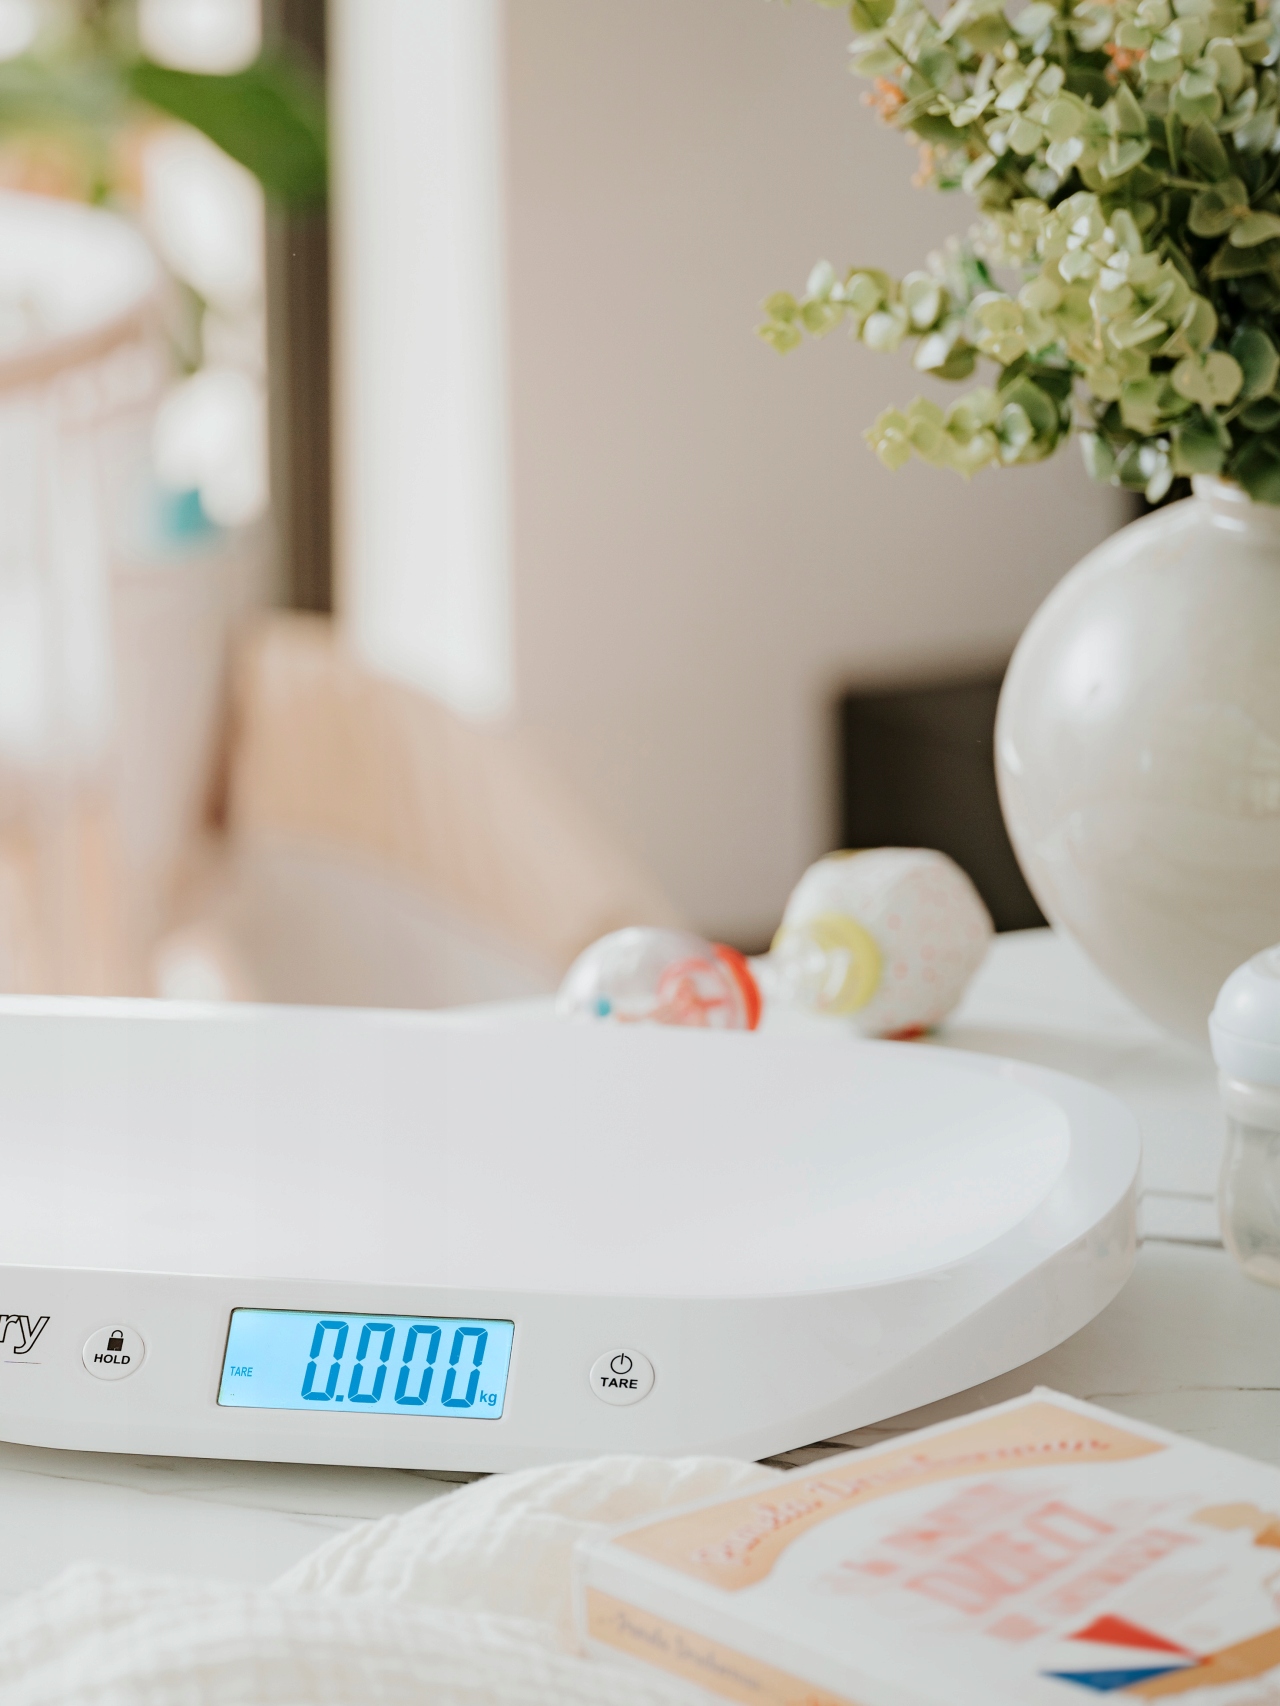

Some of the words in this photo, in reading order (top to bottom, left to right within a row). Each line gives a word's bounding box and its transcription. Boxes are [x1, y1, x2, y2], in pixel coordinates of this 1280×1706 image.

[94, 1353, 131, 1365] HOLD
[300, 1320, 489, 1408] 0.000
[479, 1390, 498, 1406] kg
[229, 1365, 254, 1378] TARE
[600, 1376, 639, 1390] TARE
